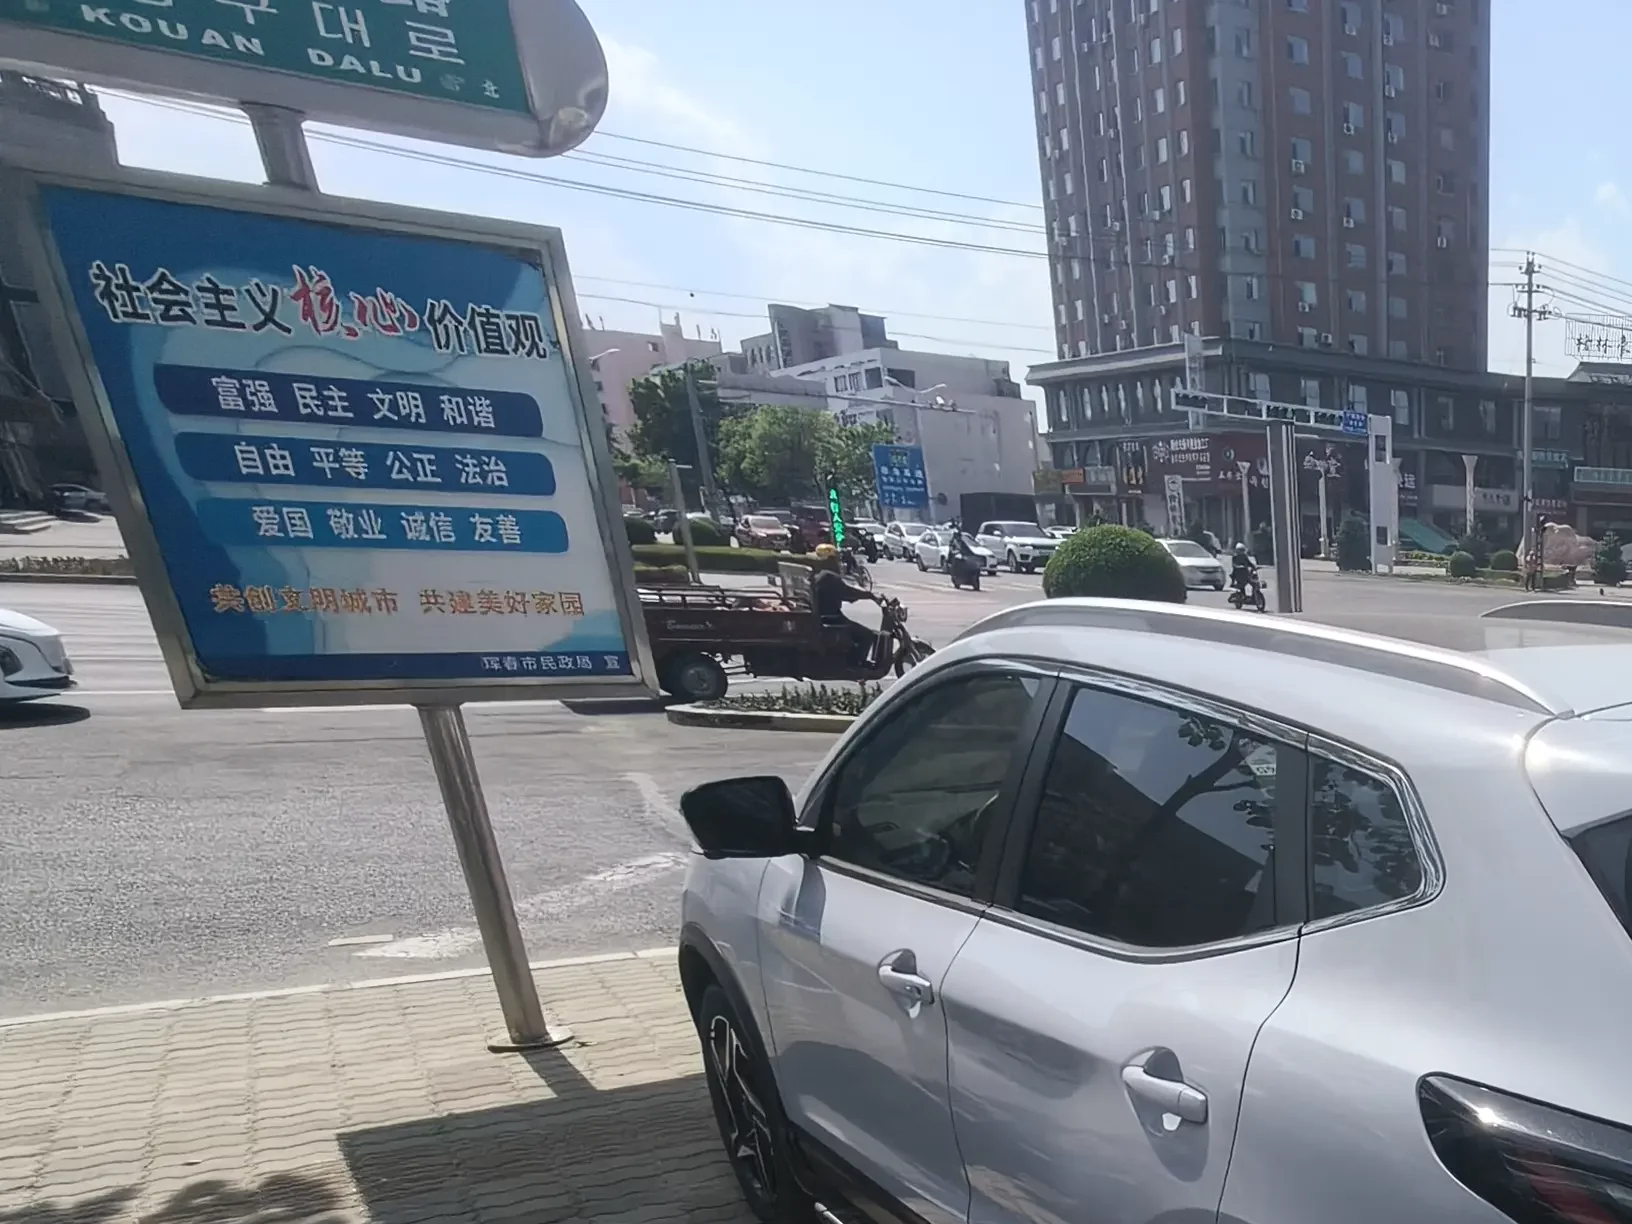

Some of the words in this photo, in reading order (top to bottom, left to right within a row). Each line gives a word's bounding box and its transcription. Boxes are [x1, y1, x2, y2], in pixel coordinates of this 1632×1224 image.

[81, 4, 265, 56] KOUAN
[307, 48, 422, 83] DALU
[211, 375, 278, 414] 富强
[293, 382, 354, 419] 民主
[368, 388, 427, 424] 文明
[440, 394, 496, 429] 和谐
[234, 441, 296, 478] 自由
[310, 446, 369, 481] 平等
[386, 450, 442, 484] 公正
[454, 453, 509, 487] 法治
[252, 505, 314, 540] 爱国
[326, 508, 387, 540] 敬业
[400, 511, 456, 544] 诚信
[469, 513, 521, 545] 友善
[210, 581, 399, 616] 共创文明城市
[419, 588, 585, 617] 共建美好家园
[481, 655, 592, 671] 珲春市民政局
